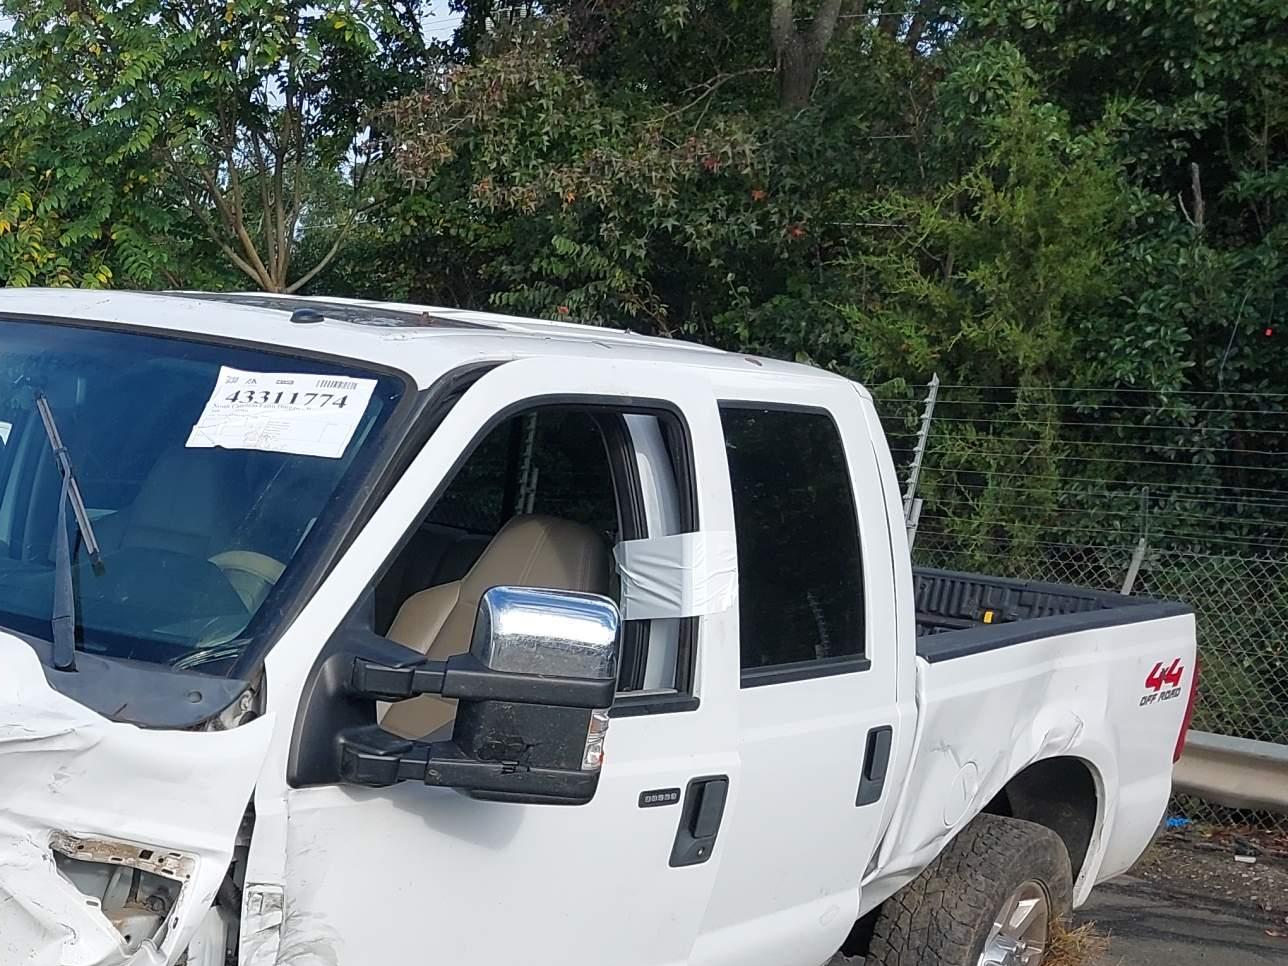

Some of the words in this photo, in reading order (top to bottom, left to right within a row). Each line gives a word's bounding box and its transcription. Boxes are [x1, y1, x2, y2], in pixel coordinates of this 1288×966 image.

[225, 390, 349, 409] 43311774
[1139, 693, 1158, 706] OFF
[1158, 687, 1182, 702] ROAD
